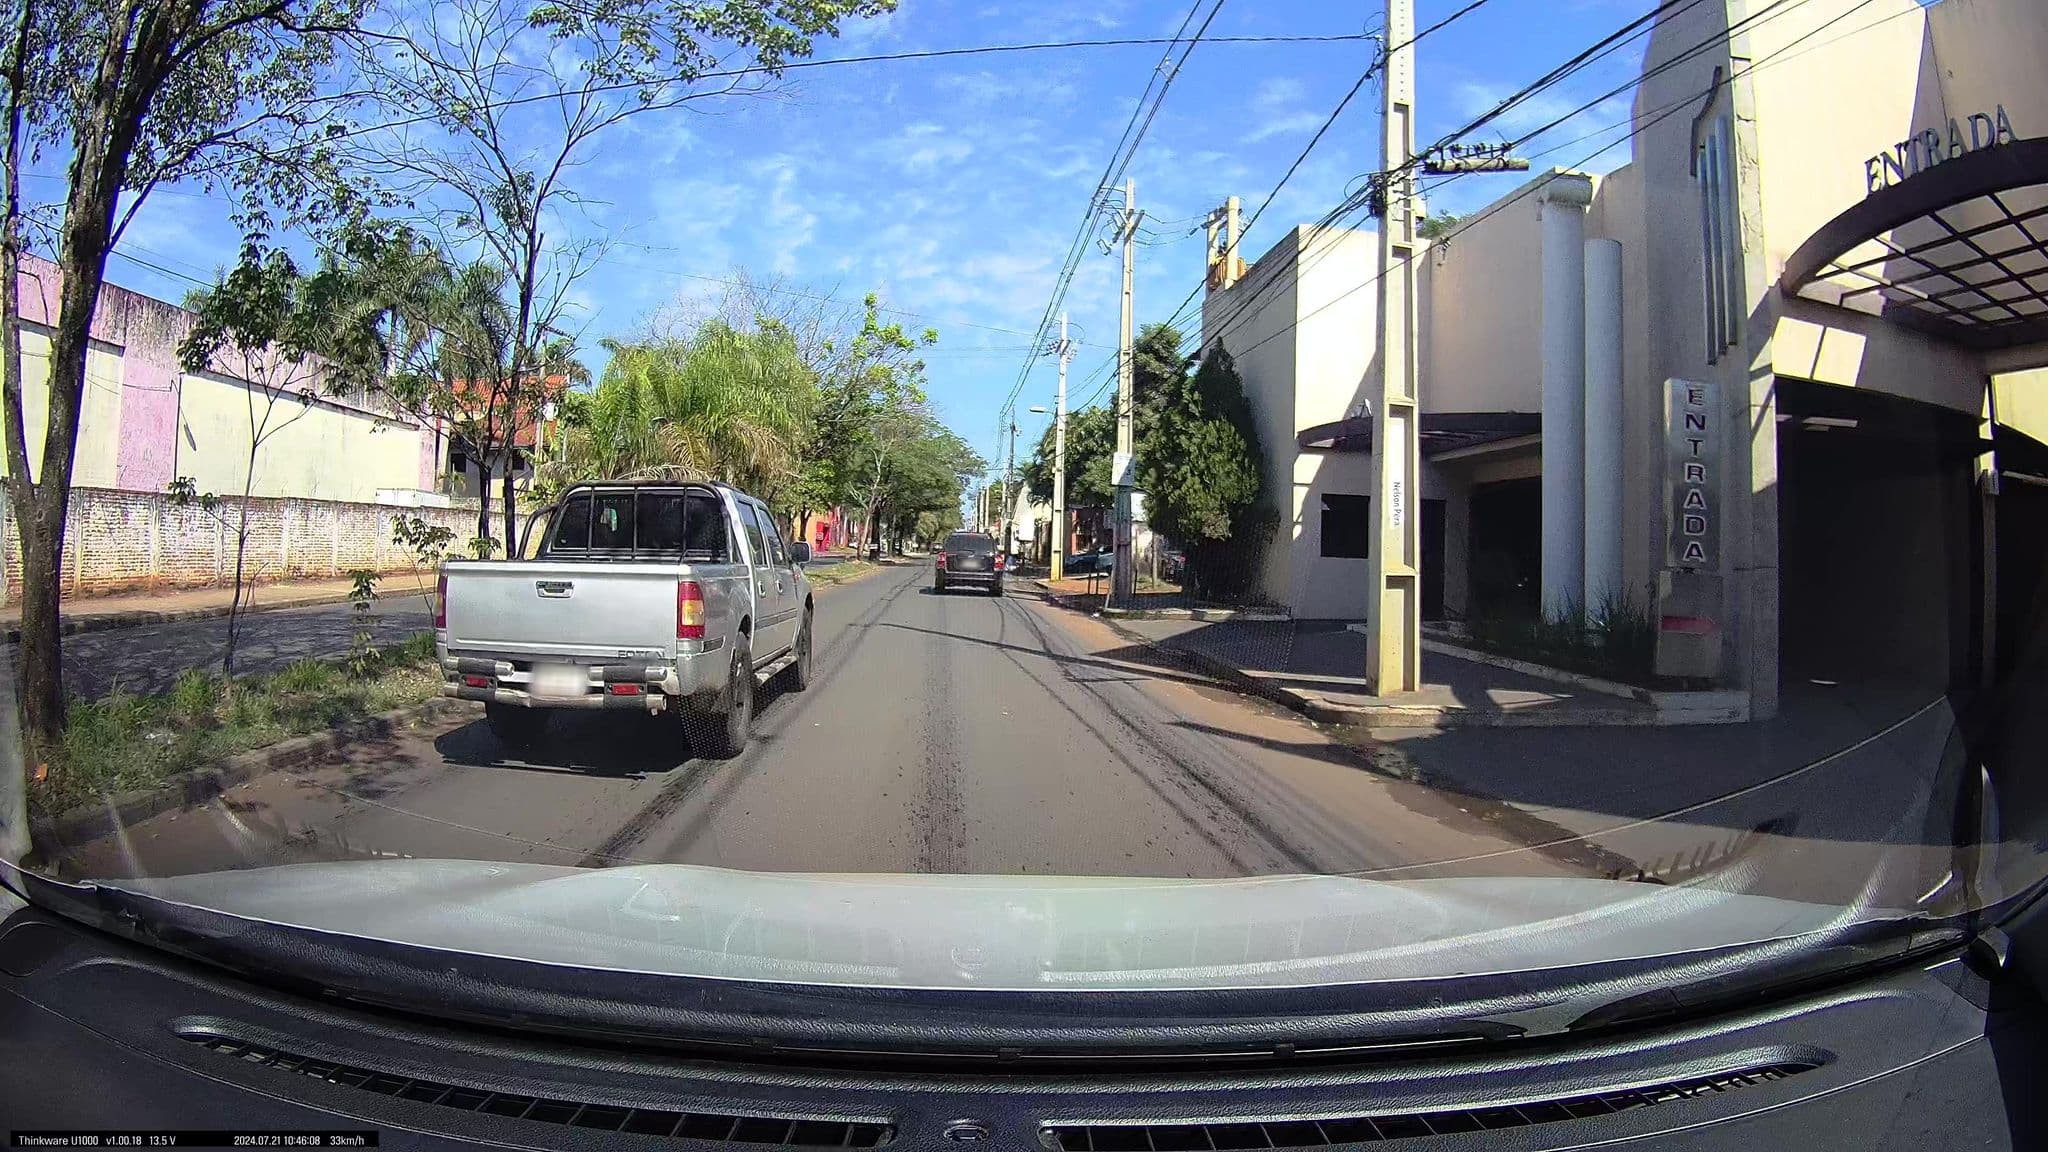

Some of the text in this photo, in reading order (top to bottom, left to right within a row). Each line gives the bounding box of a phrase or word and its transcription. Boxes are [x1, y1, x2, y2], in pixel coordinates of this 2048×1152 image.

[1863, 104, 2019, 195] ENTRADA
[1393, 481, 1402, 508] Nelson
[1683, 388, 1707, 562] ENTRADA
